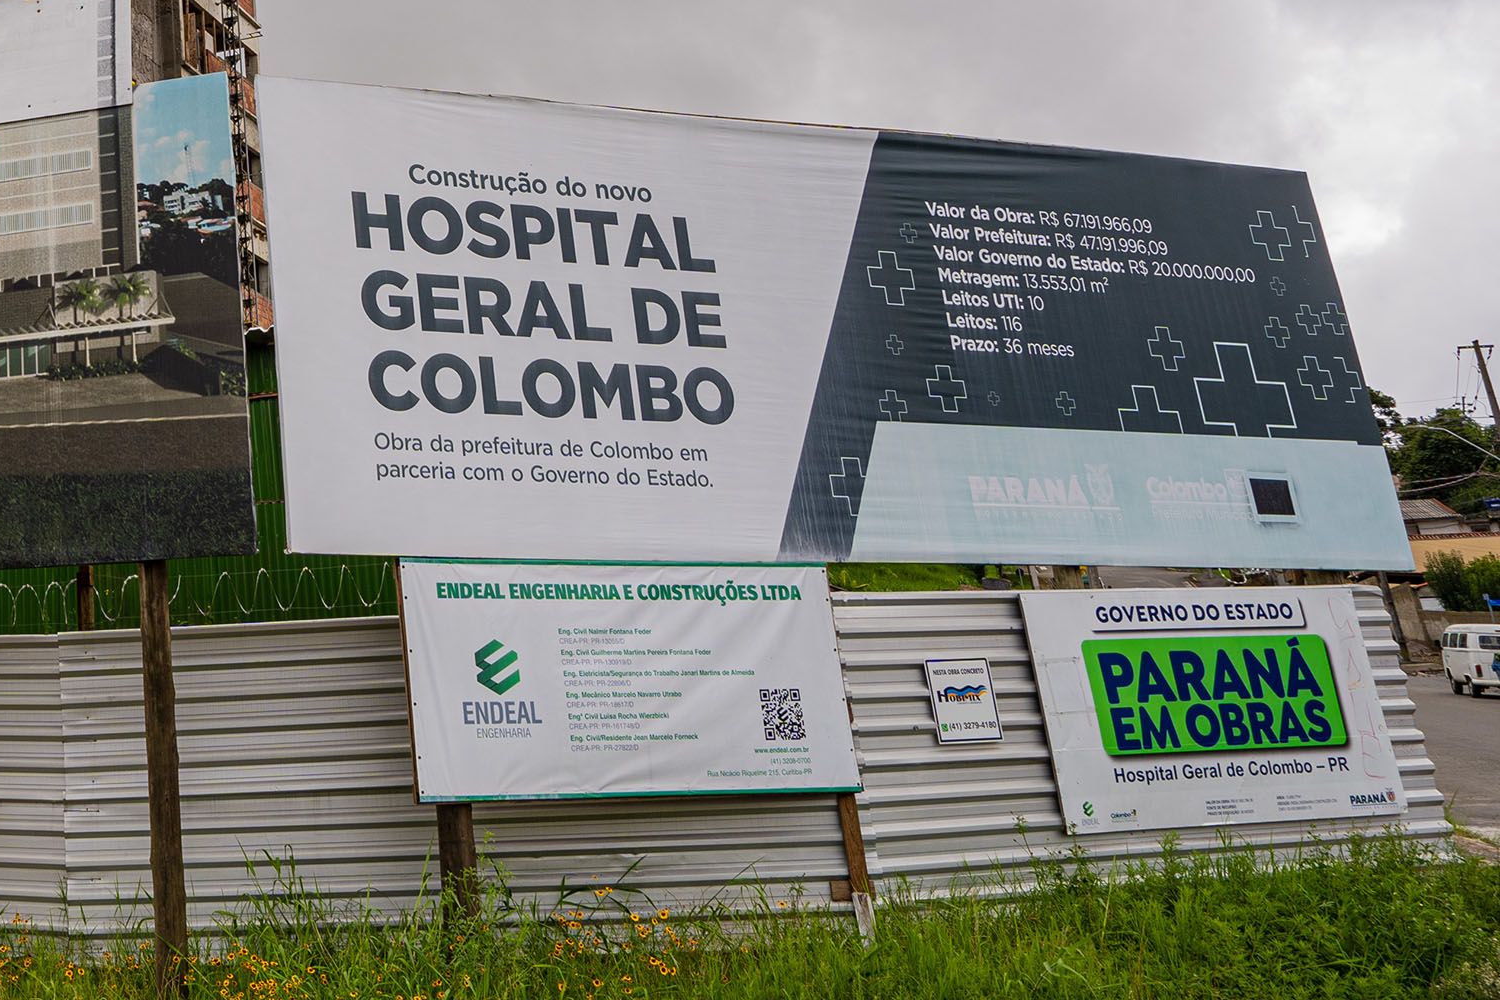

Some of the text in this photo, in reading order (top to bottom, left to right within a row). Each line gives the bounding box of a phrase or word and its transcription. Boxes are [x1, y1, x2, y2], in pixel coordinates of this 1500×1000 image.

[408, 163, 652, 202] Construção do novo
[925, 201, 1152, 234] Valor da Obra: R$ 67.191.966,09
[351, 190, 716, 274] HOSPITAL
[929, 223, 1168, 256] Valor Prefeitura: R$ 47.191.996,09
[933, 245, 1256, 284] Valor Governo do Estado: R$ 20.000.000,00
[938, 267, 1109, 293] Metragem: 13.553,01 m²
[361, 269, 727, 349] GERAL DE
[941, 289, 1045, 311] Leitos UTI: 10
[946, 312, 1023, 332] Leitos: 116
[950, 335, 1075, 357] Prazo: 36 meses
[368, 349, 735, 425] COLOMBO
[374, 432, 708, 461] Obra da prefeitura de Colombo em
[376, 461, 714, 488] parceria com o Governo do Estado.
[969, 474, 1089, 504] PARANÁ
[1146, 475, 1228, 501] Colombo
[436, 580, 802, 606] ENDEAL ENGENHARIA E CONSTRUÇÕES LTDA
[1095, 603, 1293, 623] GOVERNO DO ESTADO
[558, 628, 572, 636] Eng.
[573, 627, 587, 635] Civil
[609, 627, 634, 635] Fontana
[634, 627, 652, 635] Feder
[561, 648, 712, 657] Eng. Civil Guilherme Martins Pereira Fontana Feder
[563, 670, 577, 678] Eng.
[644, 669, 652, 677] do
[653, 669, 679, 677] Trabalho
[1098, 636, 1324, 705] PARANÁ
[566, 691, 580, 699] Eng.
[462, 701, 542, 725] ENDEAL
[949, 721, 997, 731] (41) 3279-4180
[1110, 699, 1332, 751] EM OBRAS
[476, 727, 532, 739] ENGENHARIA
[570, 735, 583, 743] Eng.
[586, 734, 633, 742] Civil/Residente
[754, 746, 809, 754] www.endeal.com.br
[770, 758, 782, 766] (41)
[1114, 764, 1178, 785] Hospital
[1182, 763, 1222, 779] Geral
[1227, 762, 1244, 778] de
[1248, 759, 1313, 776] Colombo
[1328, 756, 1349, 773] PR
[1349, 791, 1387, 804] PARANÁ
